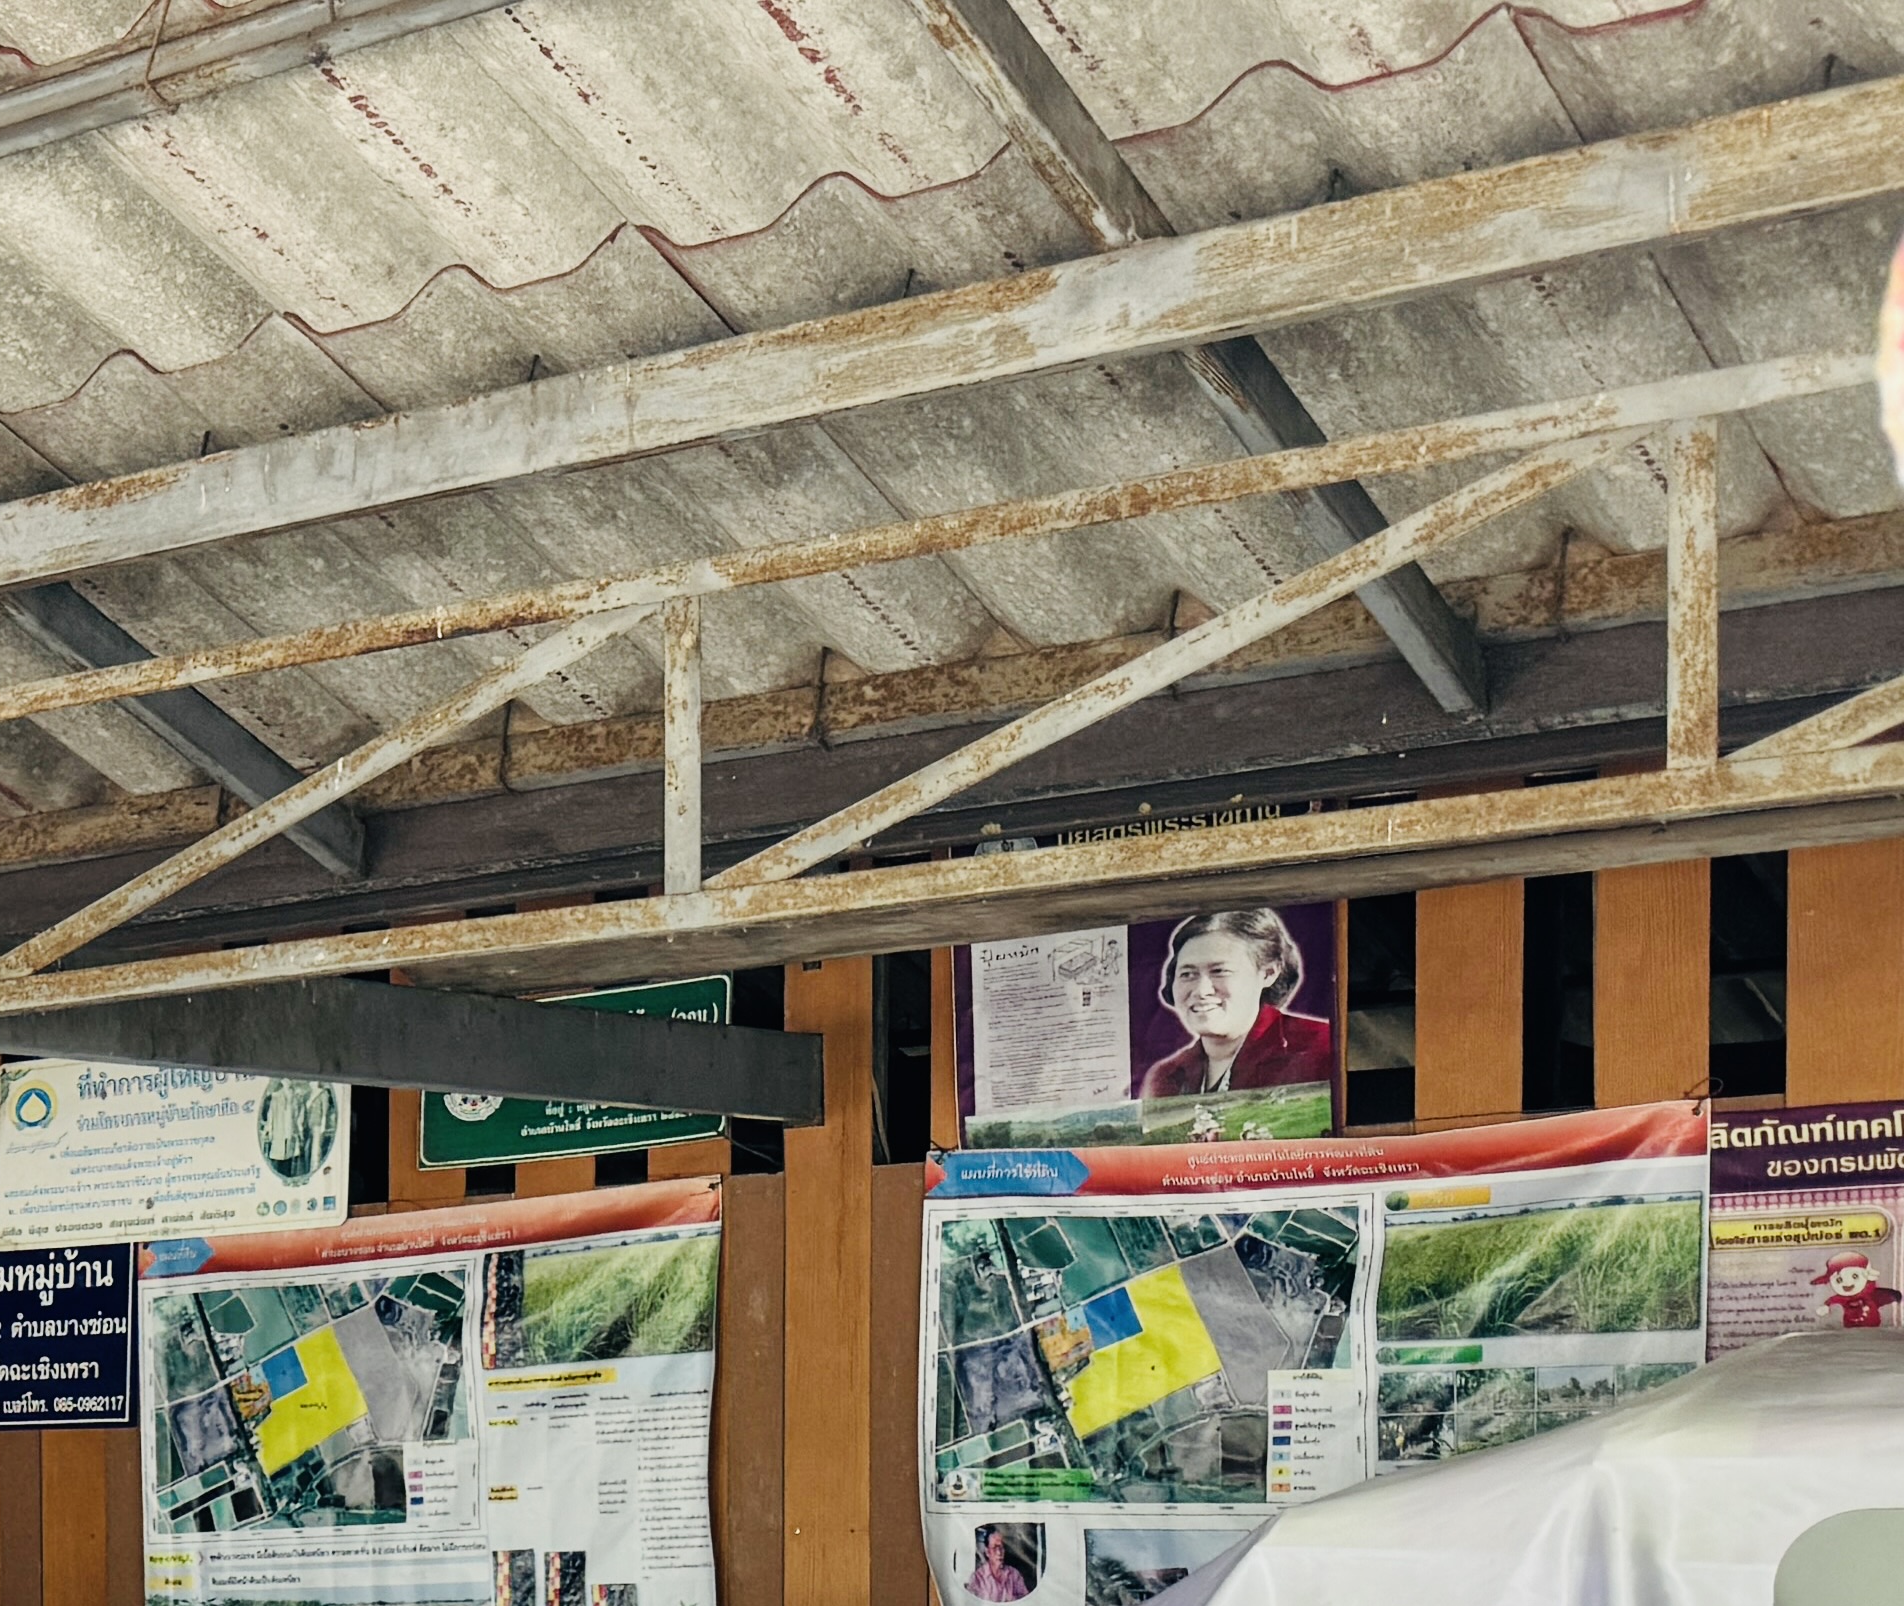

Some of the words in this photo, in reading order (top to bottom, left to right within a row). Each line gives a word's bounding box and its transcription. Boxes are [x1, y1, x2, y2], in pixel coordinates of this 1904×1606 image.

[11, 1311, 127, 1340] ตำบลบางซ่อน
